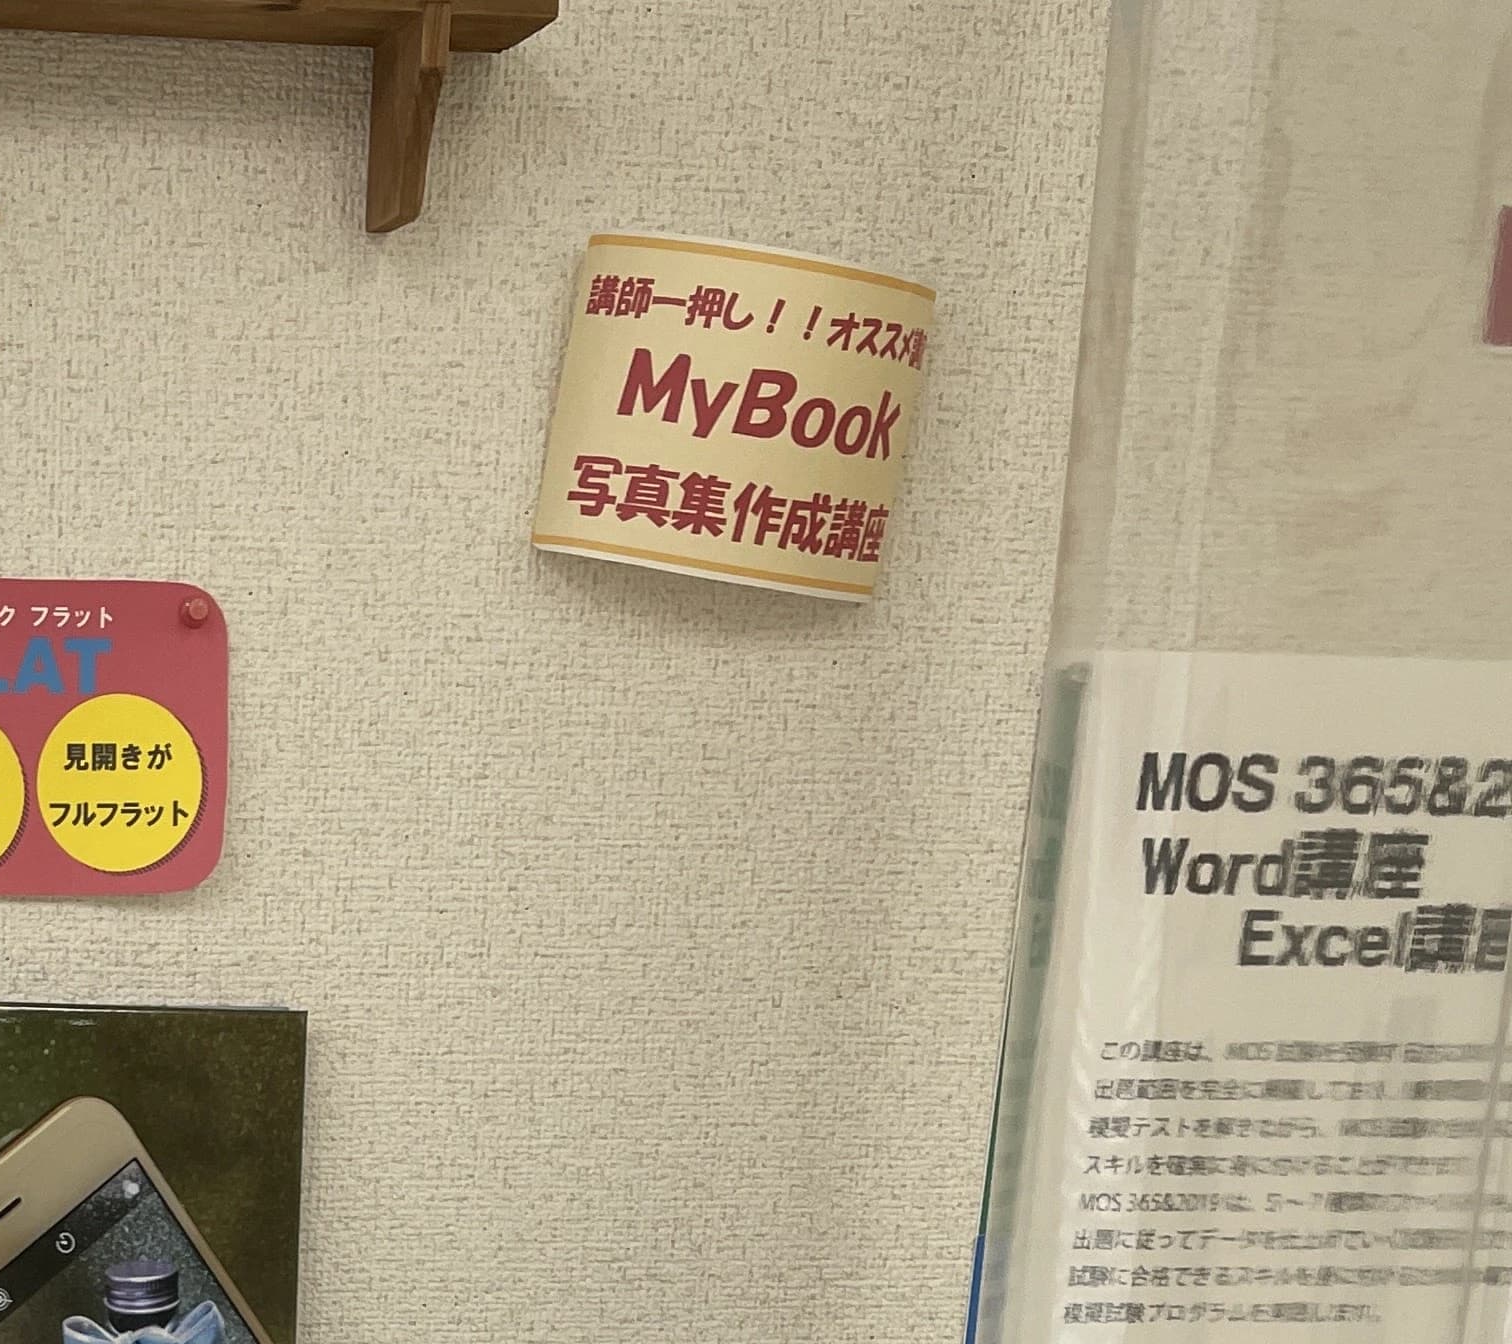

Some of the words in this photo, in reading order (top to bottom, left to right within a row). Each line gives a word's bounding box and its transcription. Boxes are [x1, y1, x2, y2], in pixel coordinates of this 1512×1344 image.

[615, 347, 902, 462] MyBook
[566, 454, 890, 563] 写真集作成講座
[31, 606, 113, 629] フラット
[64, 743, 172, 771] 見開きが
[1136, 752, 1279, 813] MOS
[48, 800, 189, 828] フルフラット
